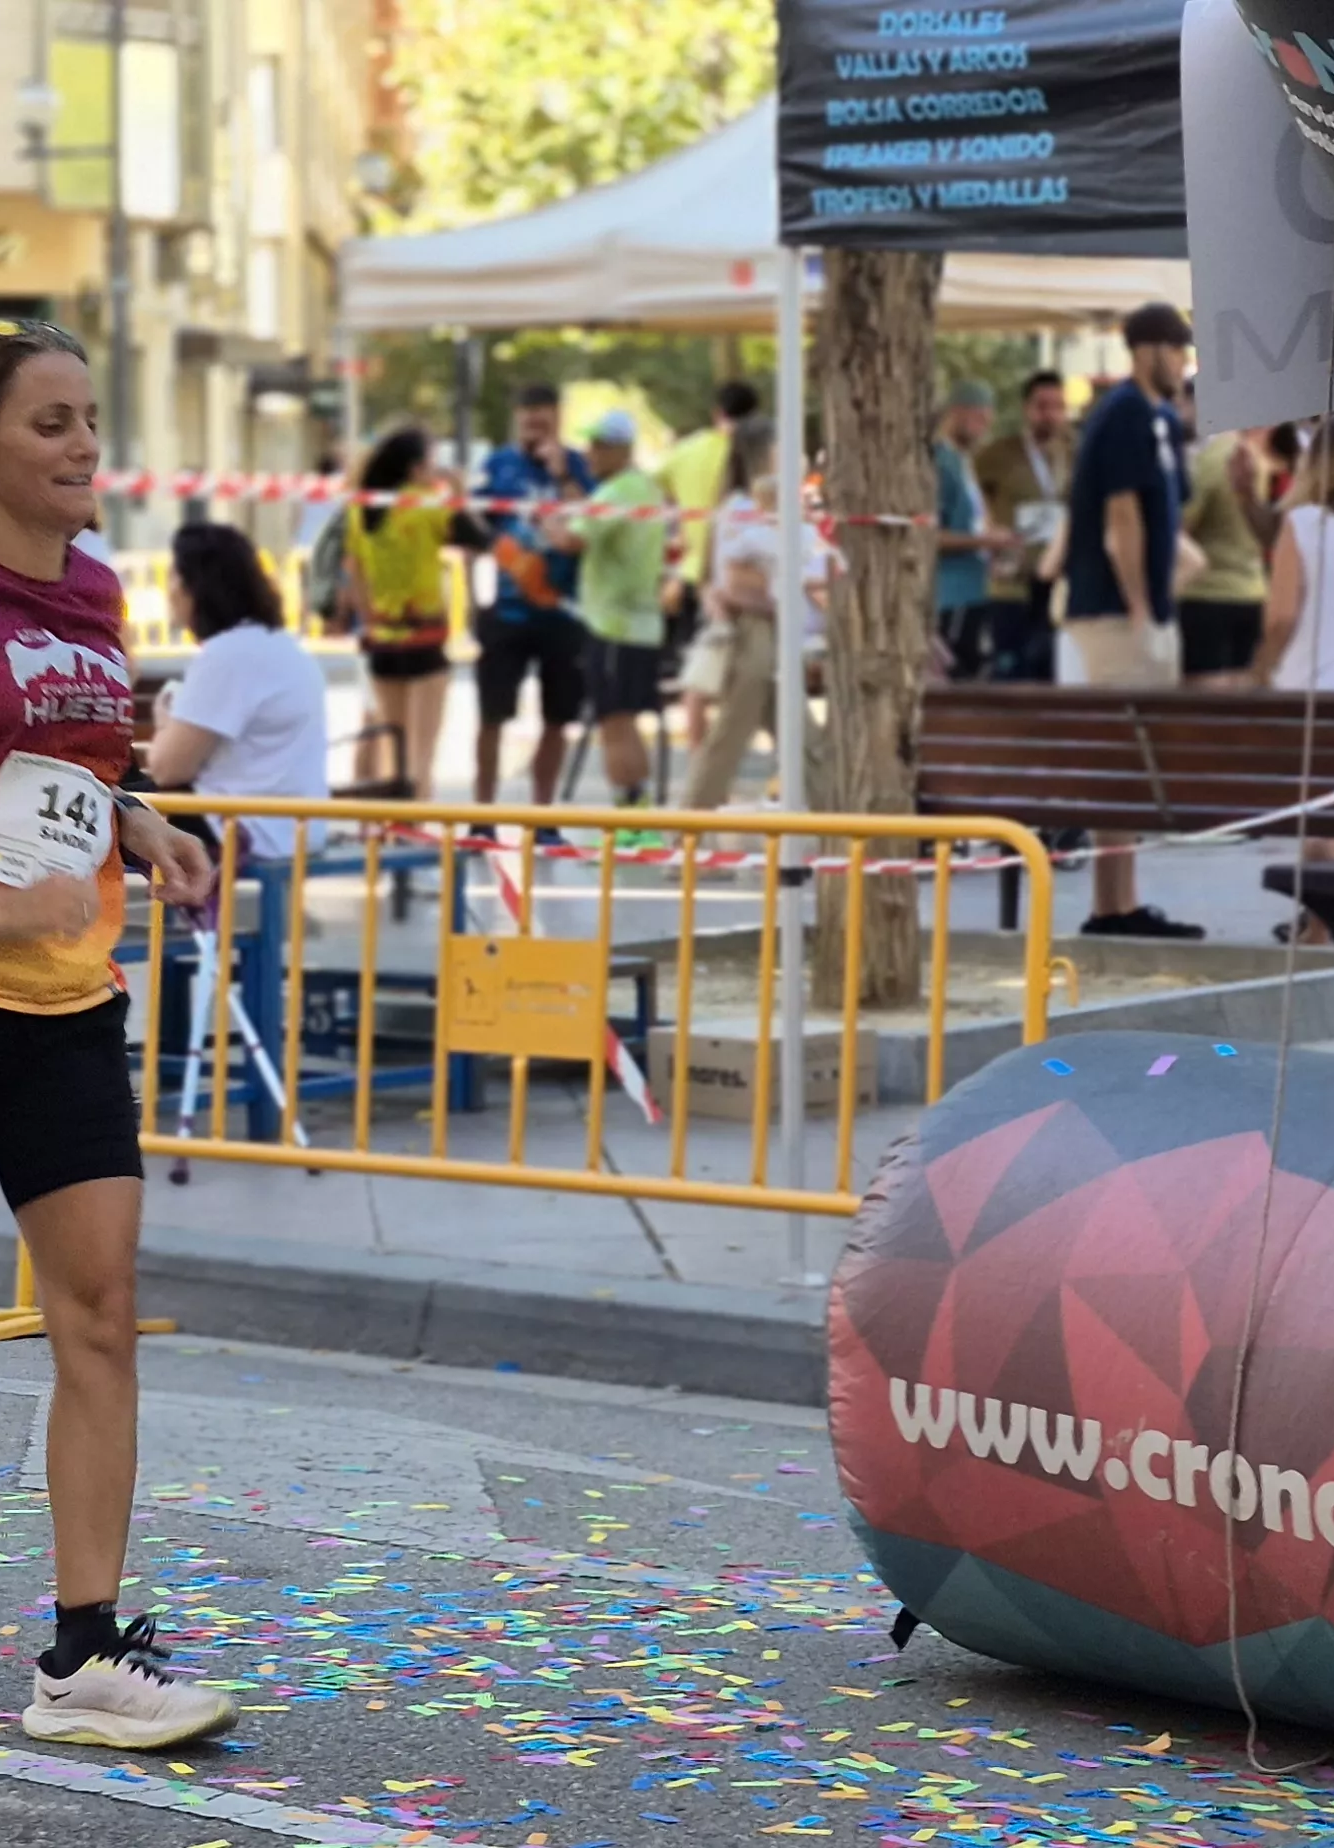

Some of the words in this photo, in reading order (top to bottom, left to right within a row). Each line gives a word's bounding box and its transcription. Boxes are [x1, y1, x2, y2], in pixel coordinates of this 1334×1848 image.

[878, 10, 1006, 37] DORSALES
[835, 50, 922, 80] VALLAS
[926, 48, 945, 76] Y
[948, 42, 1030, 73] ARCOS
[826, 98, 903, 126] BOLSA
[906, 88, 1048, 121] CORREDOR
[823, 139, 931, 169] SPEAKER
[936, 138, 954, 165] Y
[955, 132, 1055, 162] SONIDO
[812, 184, 914, 216] TROFEOS
[917, 183, 935, 209] Y
[937, 177, 1069, 208] MEDALLAS
